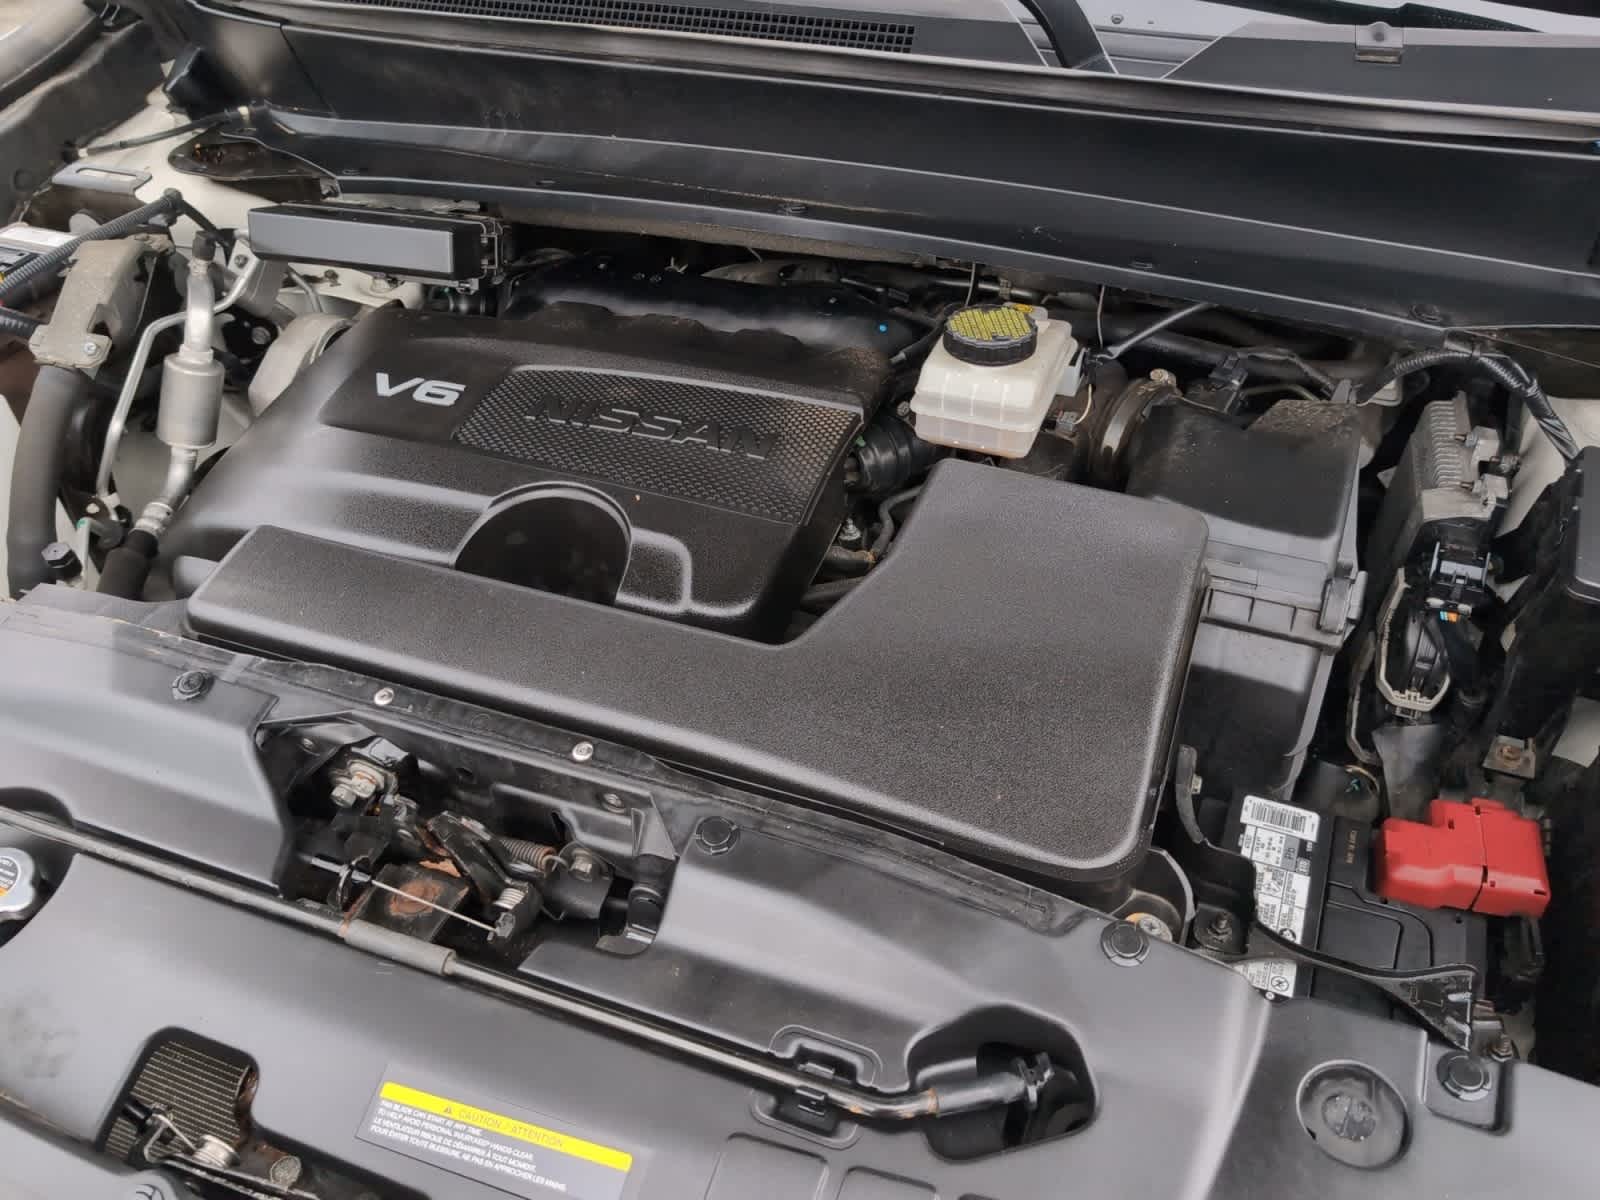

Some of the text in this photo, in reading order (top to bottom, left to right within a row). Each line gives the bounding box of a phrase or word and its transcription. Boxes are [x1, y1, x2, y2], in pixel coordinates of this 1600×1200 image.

[376, 372, 466, 406] V6
[526, 396, 778, 460] NISSAN
[460, 1110, 500, 1129] CAUTION
